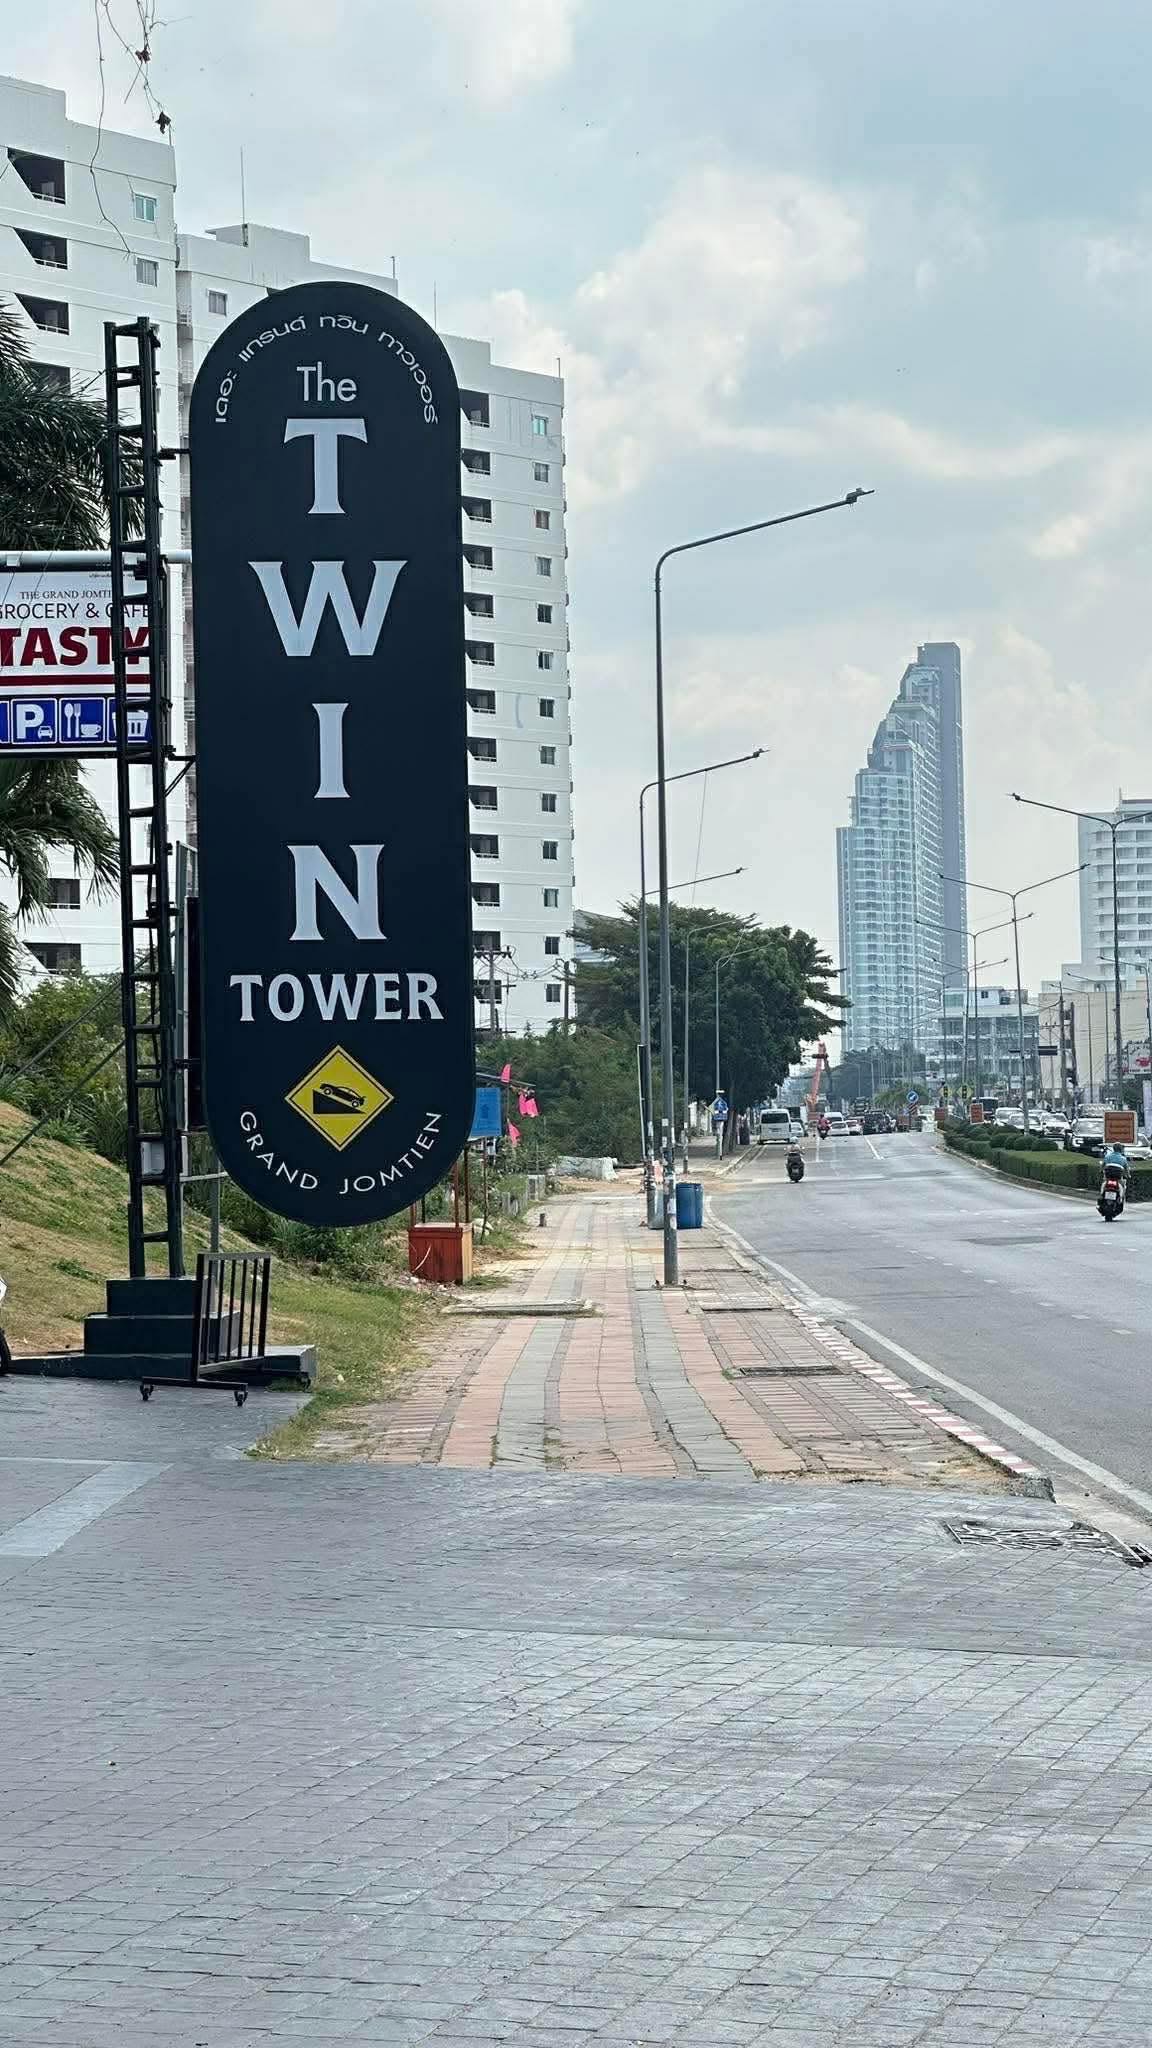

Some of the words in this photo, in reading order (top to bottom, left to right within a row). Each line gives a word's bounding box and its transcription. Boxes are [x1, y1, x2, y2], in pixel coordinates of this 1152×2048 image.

[238, 315, 307, 363] แกรนด์
[319, 315, 369, 335] ทวิน
[296, 361, 358, 402] The
[0, 603, 80, 619] ROCERY
[86, 602, 100, 619] &
[20, 591, 40, 600] THE
[42, 590, 79, 600] GRAND
[81, 590, 113, 600] JOMTI
[16, 703, 45, 740] P
[229, 973, 445, 1022] TOWER
[240, 1111, 319, 1190] GRAND
[339, 1112, 442, 1195] JOMTIEN
